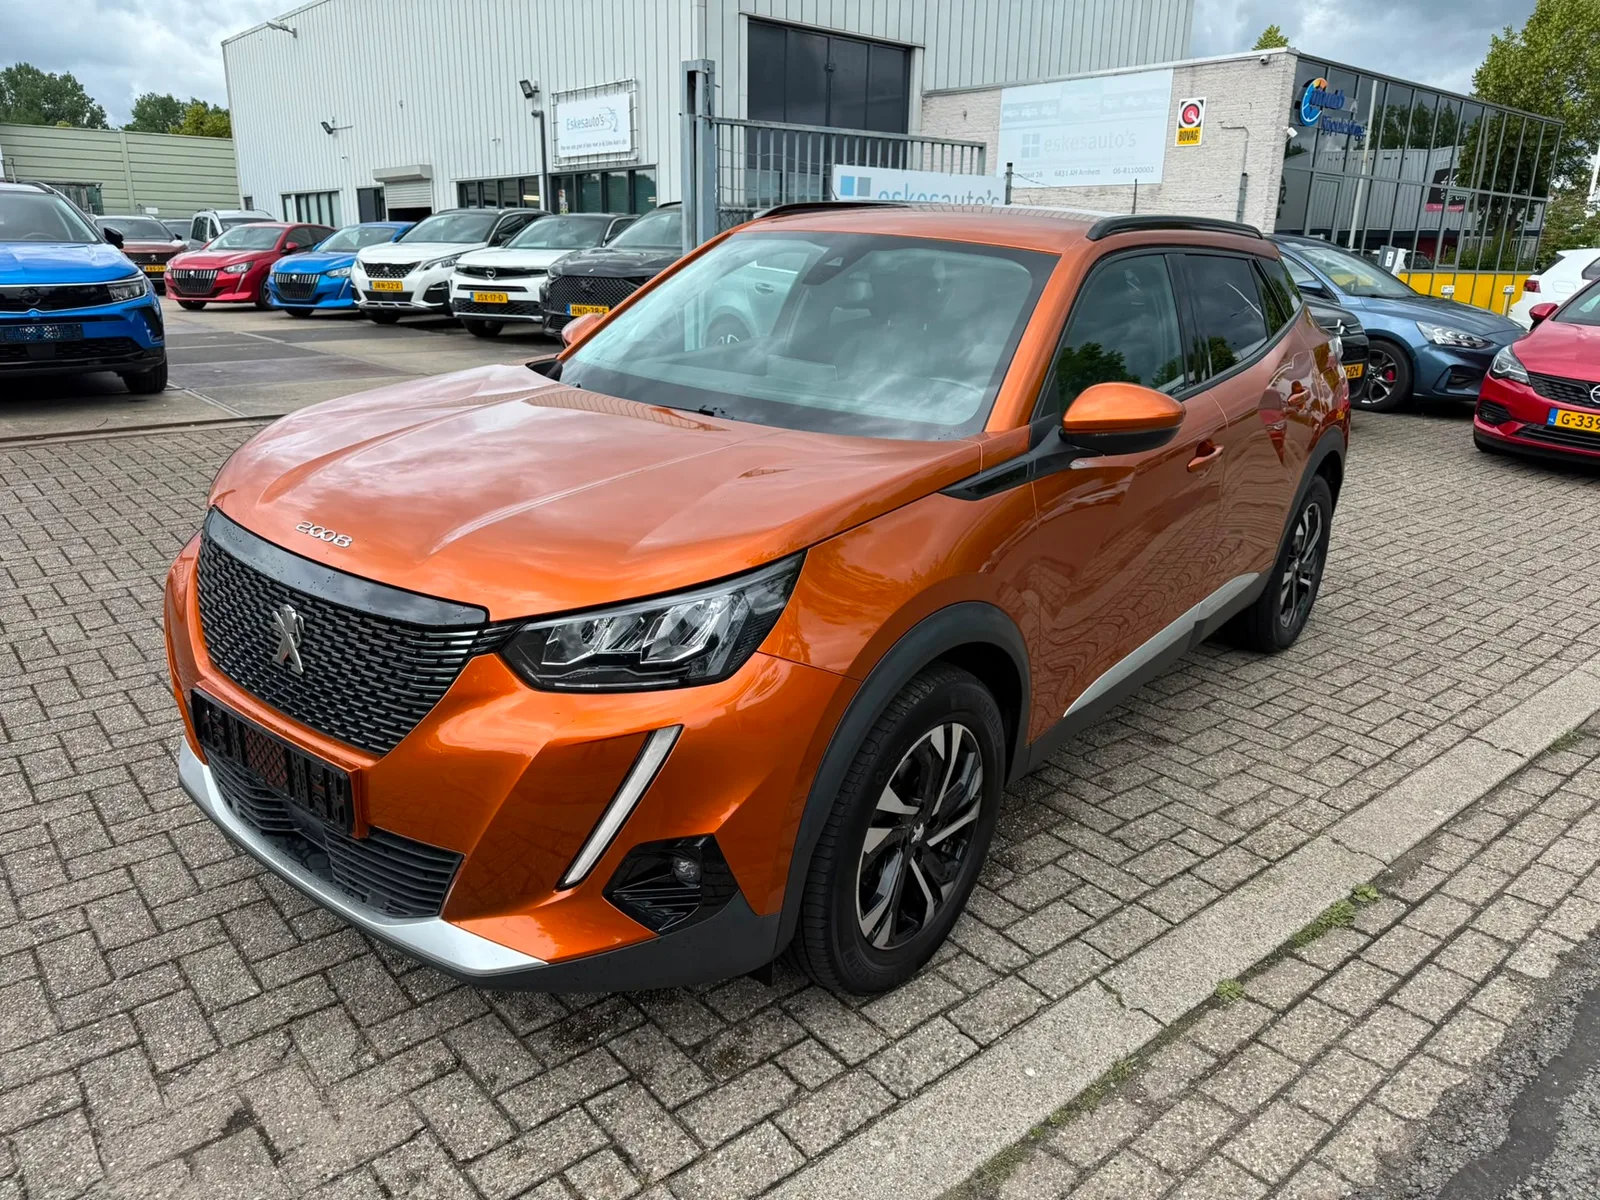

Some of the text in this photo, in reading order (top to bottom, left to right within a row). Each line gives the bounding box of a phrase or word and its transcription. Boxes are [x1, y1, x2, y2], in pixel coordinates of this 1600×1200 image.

[566, 113, 605, 131] Eskesauto's
[1043, 129, 1137, 153] eskesauto's
[1178, 129, 1198, 141] BOVAG
[295, 520, 353, 548] 2008
